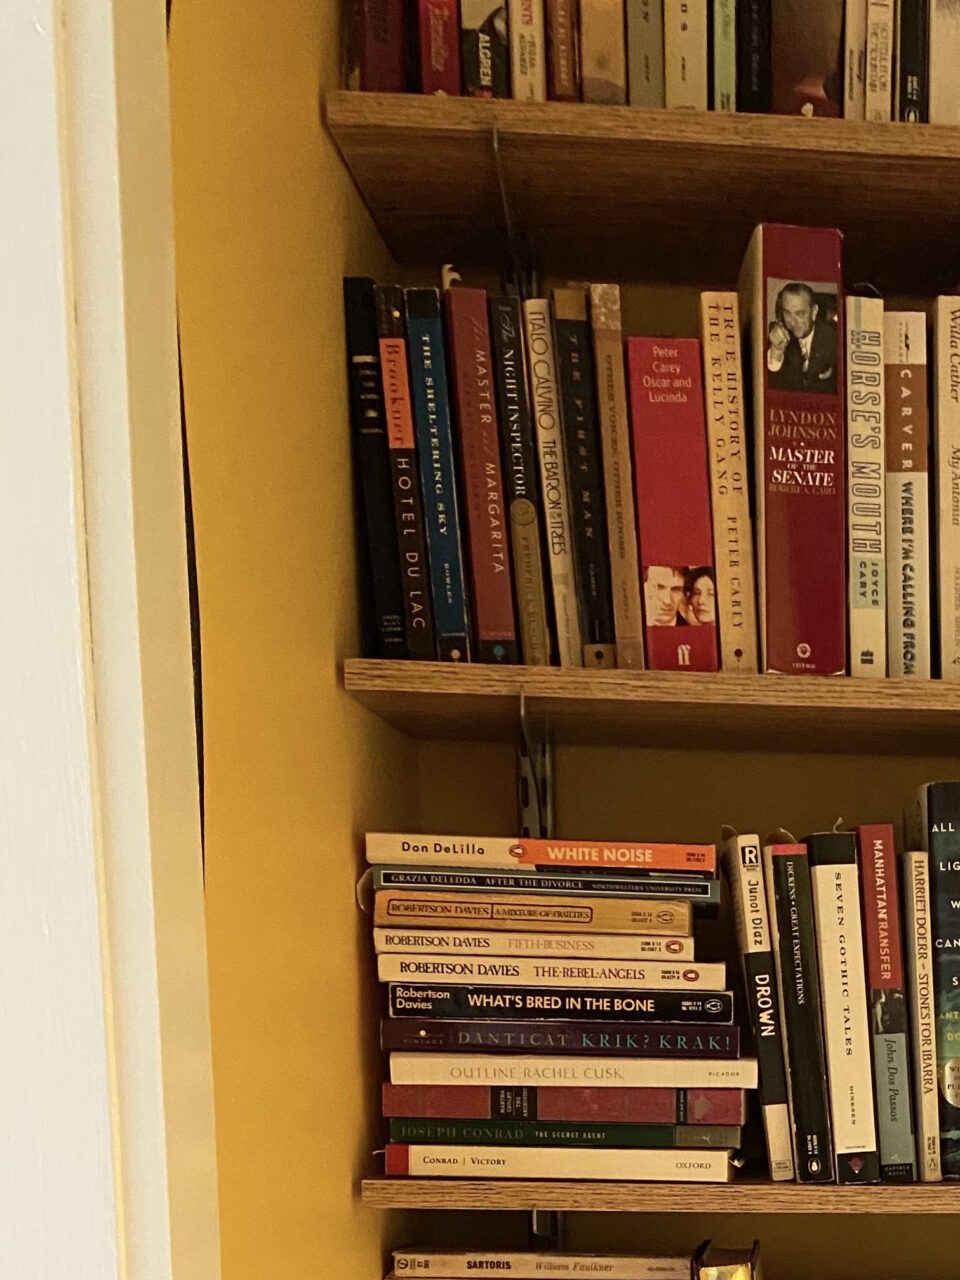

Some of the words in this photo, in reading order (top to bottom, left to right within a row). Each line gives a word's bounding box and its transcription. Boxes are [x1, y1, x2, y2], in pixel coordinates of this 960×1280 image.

[652, 346, 678, 358] Peter
[652, 361, 681, 375] Carey
[643, 376, 669, 388] Oscar
[672, 376, 691, 388] and
[649, 391, 687, 403] Lucinda
[901, 368, 912, 470] CARVER
[769, 446, 835, 463] MASTER
[772, 469, 833, 487] SENATE
[396, 458, 416, 535] HOTEL
[851, 461, 882, 553] MOUTH
[406, 552, 419, 578] DU
[409, 592, 426, 629] LAC
[932, 822, 958, 833] ALL
[401, 842, 428, 853] Don
[433, 843, 485, 856] DeLillo
[547, 847, 599, 861] WHITE
[603, 847, 653, 862] NOISE
[484, 878, 515, 887] AFTER
[519, 878, 537, 887] THE
[541, 879, 583, 889] DIVORCE
[834, 871, 844, 927] SEVEN
[838, 935, 848, 998] GOTHIC
[468, 994, 523, 1008] WHAT'S
[526, 995, 562, 1010] BRED
[565, 996, 582, 1010] IN
[584, 997, 611, 1011] THE
[613, 998, 655, 1012] BONE
[755, 974, 774, 1037] DROWN
[843, 1003, 852, 1057] TALES
[582, 1034, 649, 1049] KRIK?
[659, 1035, 730, 1050] KRAK!
[675, 1161, 711, 1170] OXFORD
